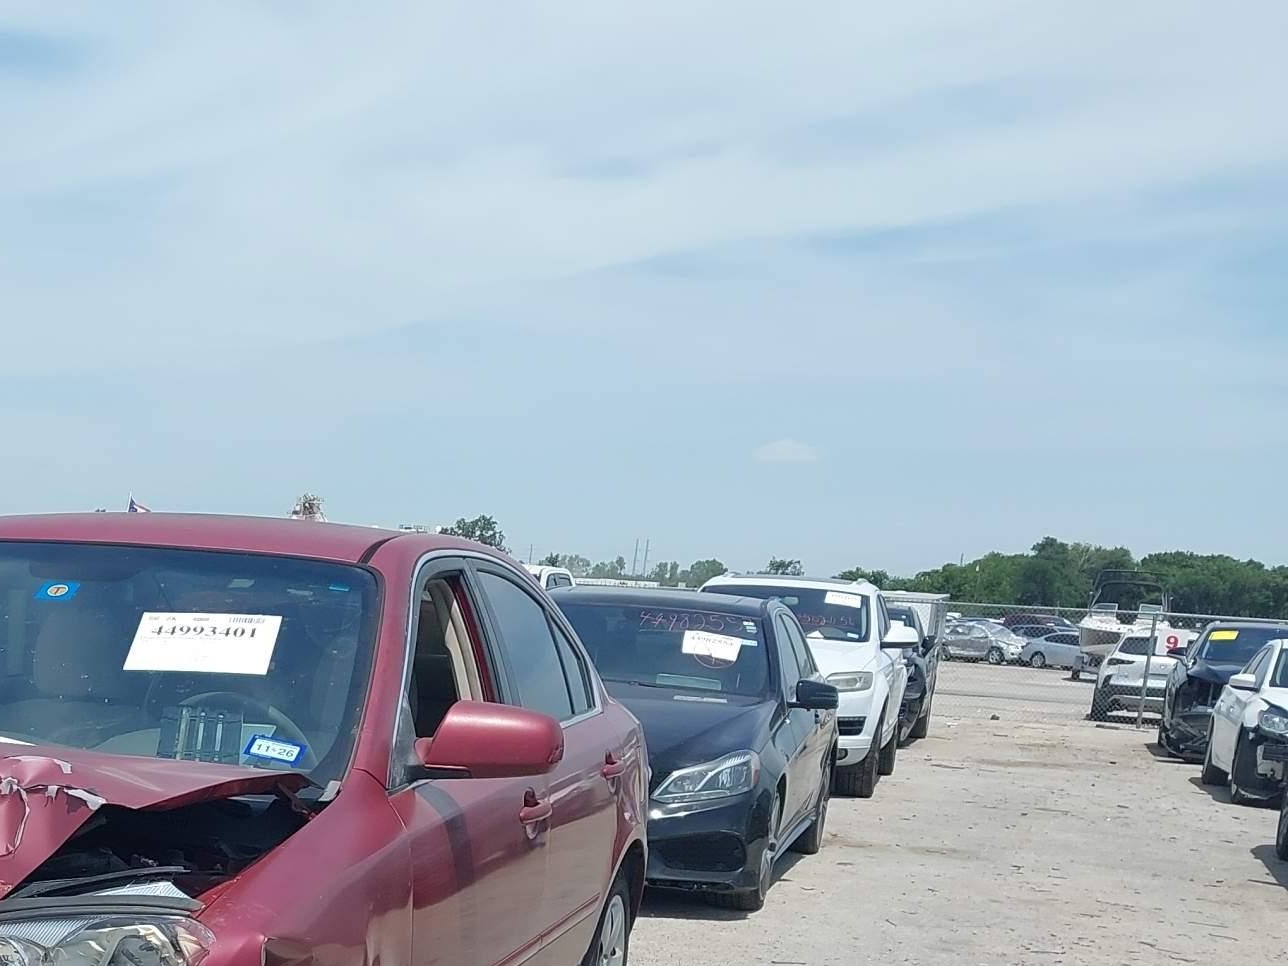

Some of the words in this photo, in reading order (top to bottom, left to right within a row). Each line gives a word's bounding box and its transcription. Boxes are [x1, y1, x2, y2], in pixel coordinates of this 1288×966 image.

[152, 625, 257, 638] 44993401
[1166, 635, 1179, 650] 9
[256, 743, 295, 758] 11-26
